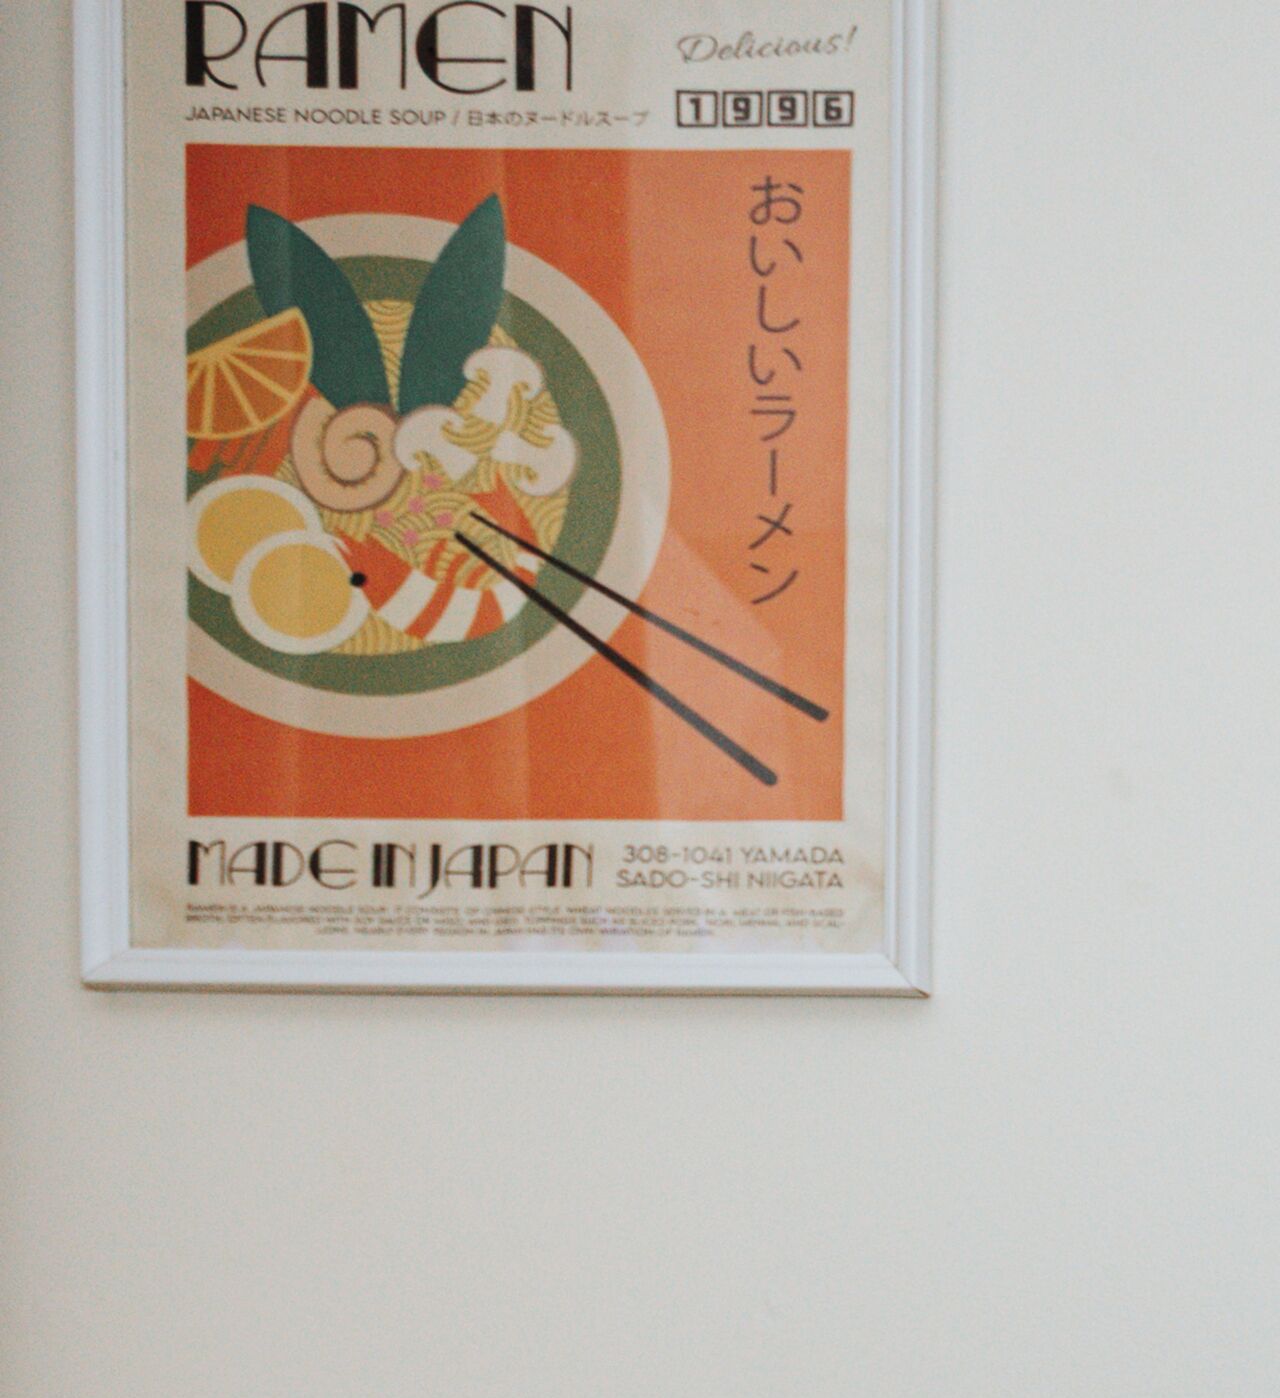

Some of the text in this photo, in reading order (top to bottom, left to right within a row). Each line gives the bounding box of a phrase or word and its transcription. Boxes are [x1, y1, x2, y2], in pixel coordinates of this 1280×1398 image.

[185, 0, 572, 95] RAMEN
[676, 25, 858, 64] Delicious!
[185, 106, 286, 123] JAPANESE
[294, 108, 381, 125] NOODLE
[389, 108, 447, 126] SOUP
[747, 174, 805, 605] おいしいラーメン
[187, 839, 594, 899] MADE IN JAPAN
[622, 844, 845, 864] 308-1041 YAMADA
[616, 869, 844, 889] SADO-SHI NIIGATA
